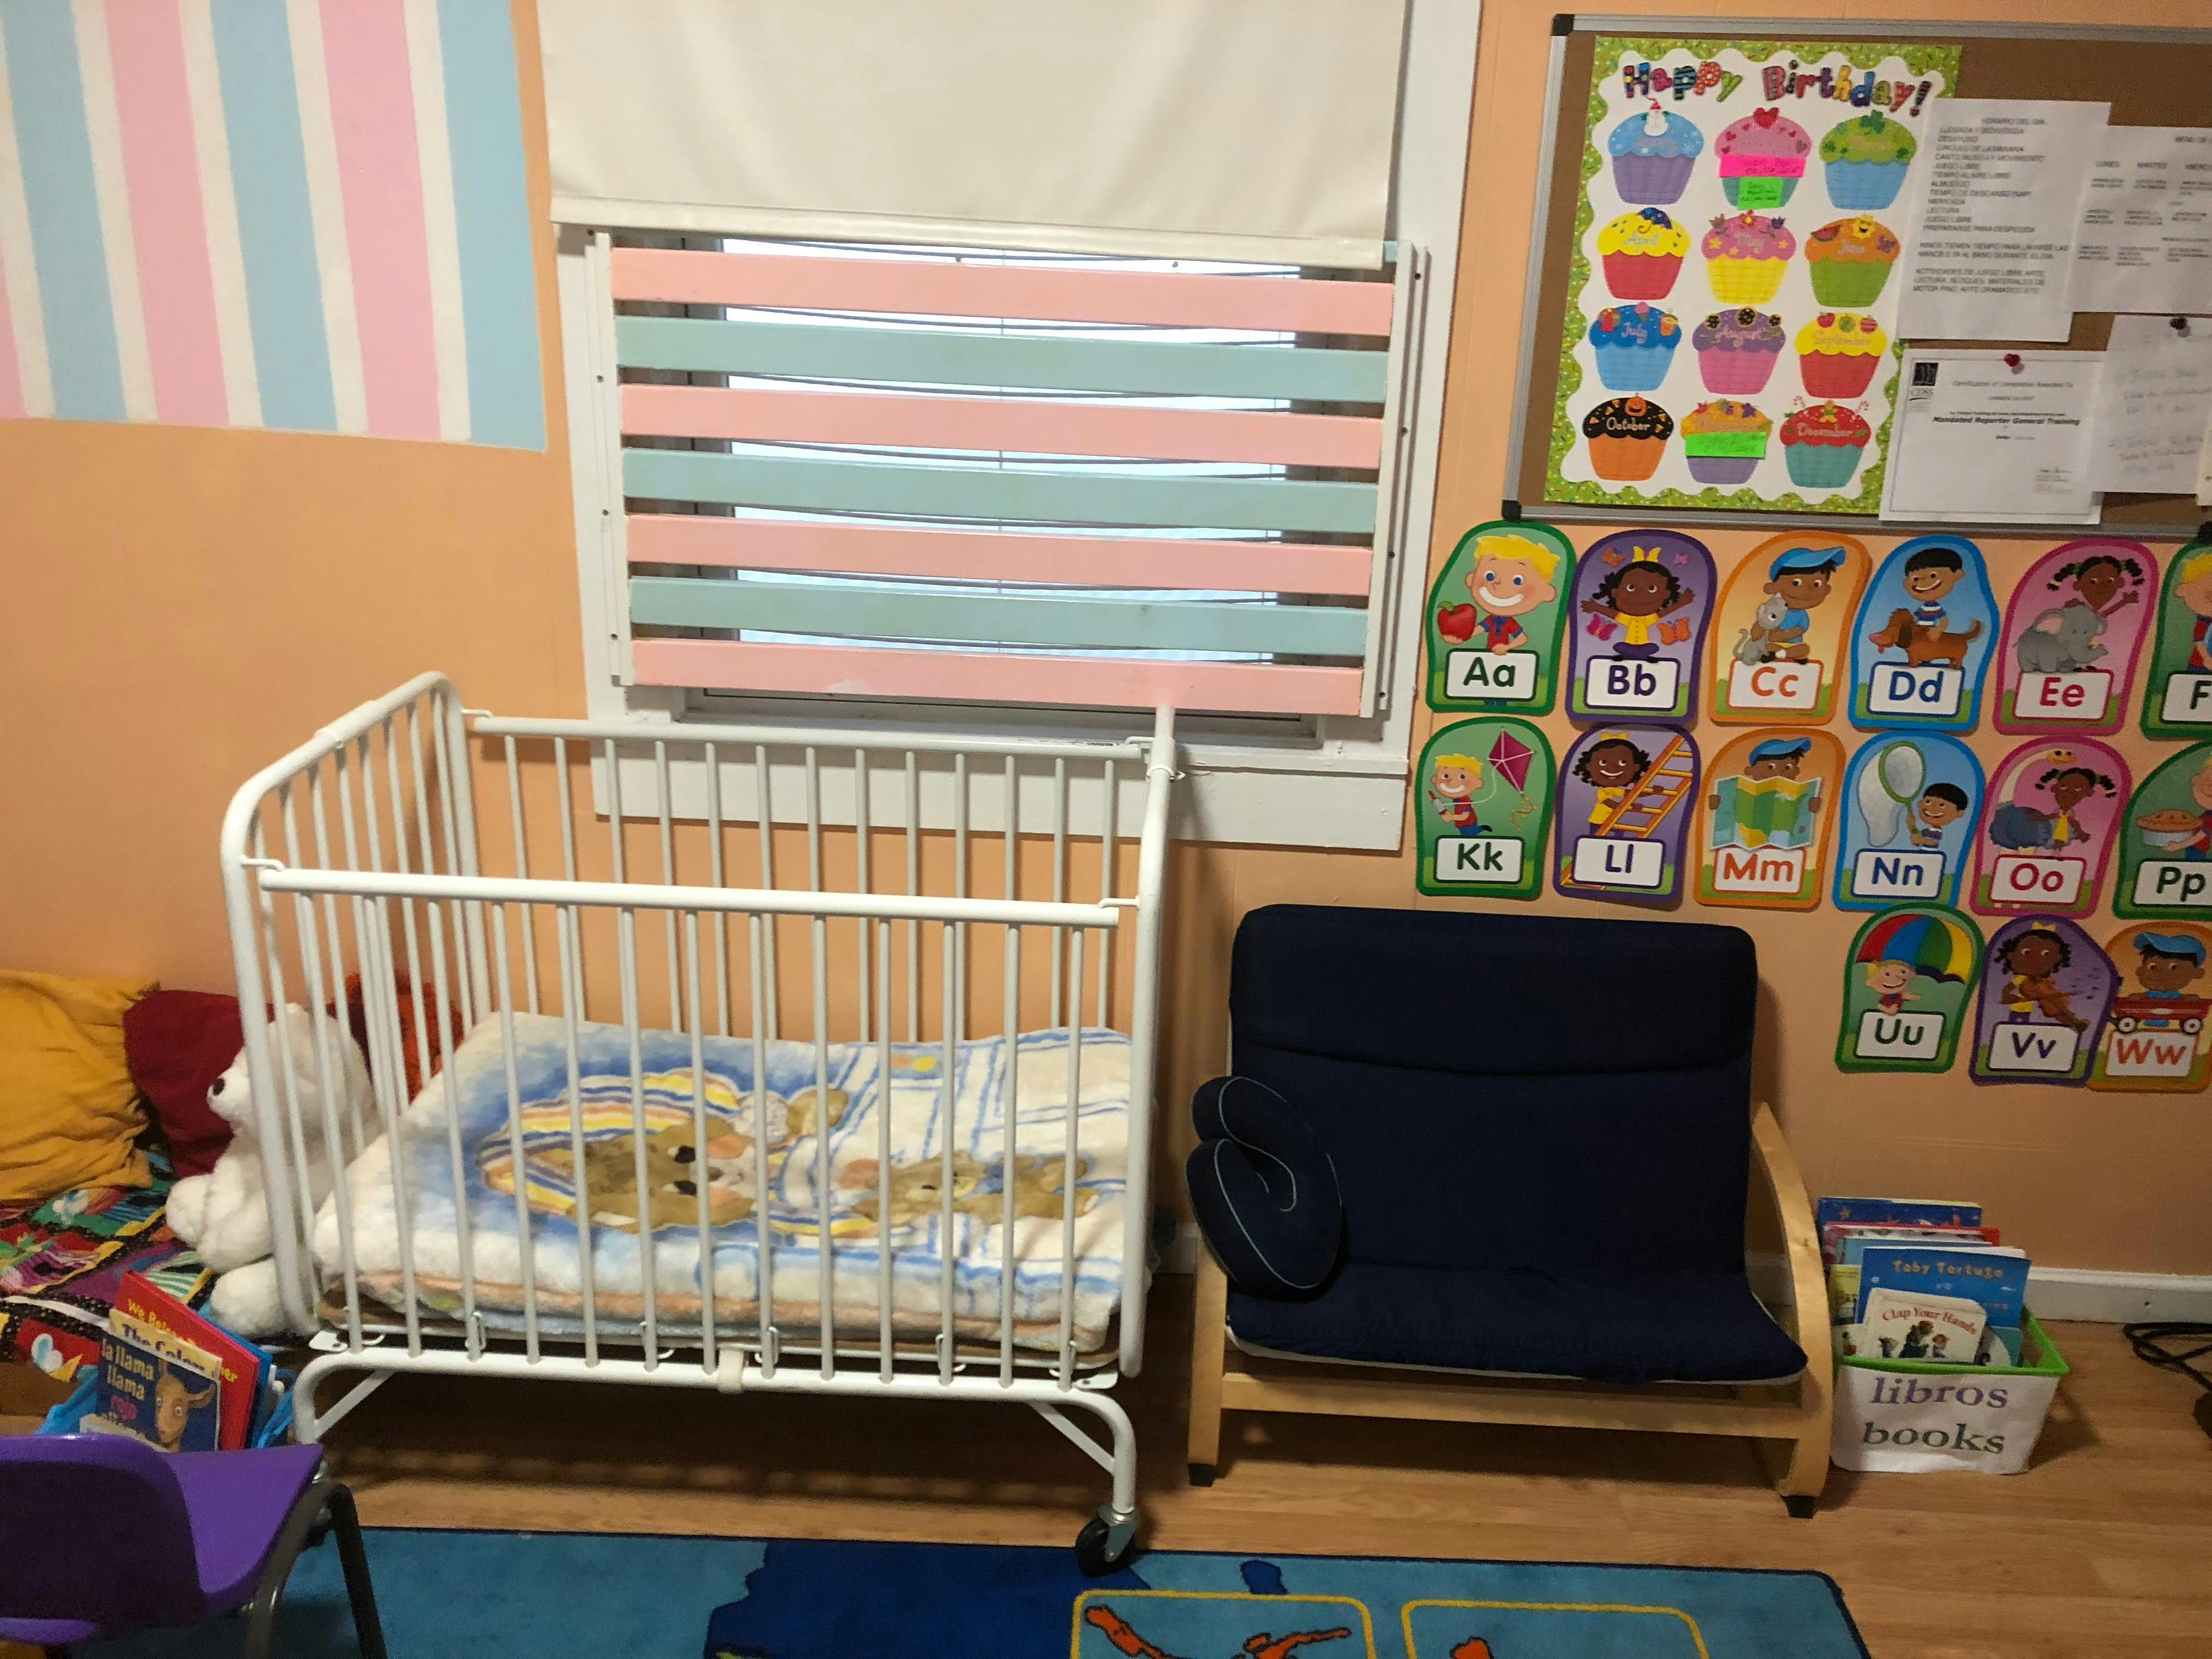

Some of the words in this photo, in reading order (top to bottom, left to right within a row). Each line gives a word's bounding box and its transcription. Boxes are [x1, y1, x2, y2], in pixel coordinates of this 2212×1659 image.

[1623, 60, 1743, 102] Happy
[1761, 59, 1932, 117] Birthday!
[1606, 416, 1651, 431] October
[1974, 416, 2011, 425] Reporter
[2046, 417, 2081, 426] Training
[1463, 657, 1516, 688] Aa
[1607, 664, 1657, 697] Bb
[1751, 667, 1799, 698] Cc
[1888, 670, 1943, 703] Dd
[2039, 676, 2085, 708] Ee
[2190, 680, 2212, 710] F
[1457, 842, 1503, 872] Kk
[1723, 853, 1793, 882] Mm
[1871, 857, 1924, 887] Nn
[2010, 863, 2063, 893] Oo
[2157, 866, 2207, 902] Pp
[1875, 1018, 1925, 1046] Uu
[2012, 1031, 2056, 1059] Vv
[2116, 1038, 2186, 1065] Ww
[1892, 1260, 1930, 1275] Toby
[1937, 1261, 2004, 1279] Tortuga
[1882, 1307, 1911, 1321] Clap
[1914, 1307, 1940, 1319] Your
[1942, 1311, 1977, 1335] Hands
[115, 1345, 154, 1381] llama
[107, 1364, 145, 1401] llama
[1871, 1376, 2008, 1408] libros
[1864, 1421, 2005, 1454] books
